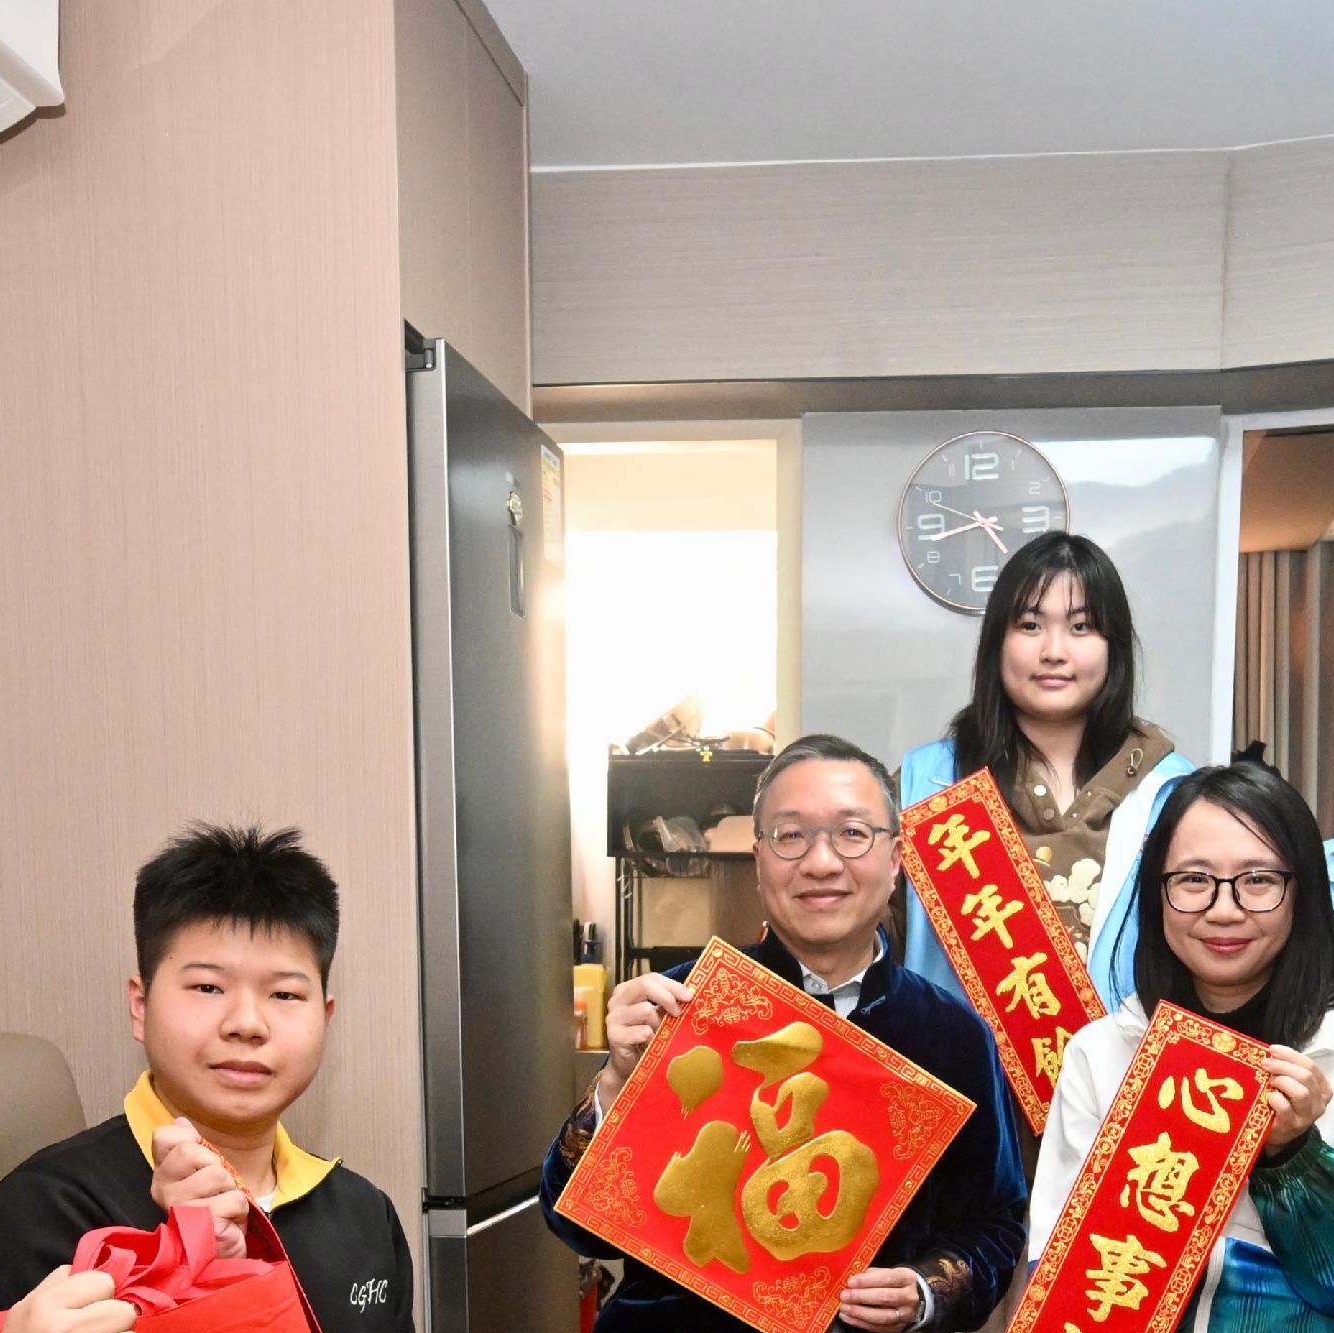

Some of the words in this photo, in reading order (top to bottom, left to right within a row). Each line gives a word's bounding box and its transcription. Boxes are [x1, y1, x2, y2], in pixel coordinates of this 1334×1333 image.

[965, 452, 999, 480] 12
[925, 490, 942, 503] 10
[1028, 481, 1040, 494] 2
[918, 514, 945, 541] 9
[1022, 506, 1050, 533] 3
[653, 1021, 880, 1274] 福
